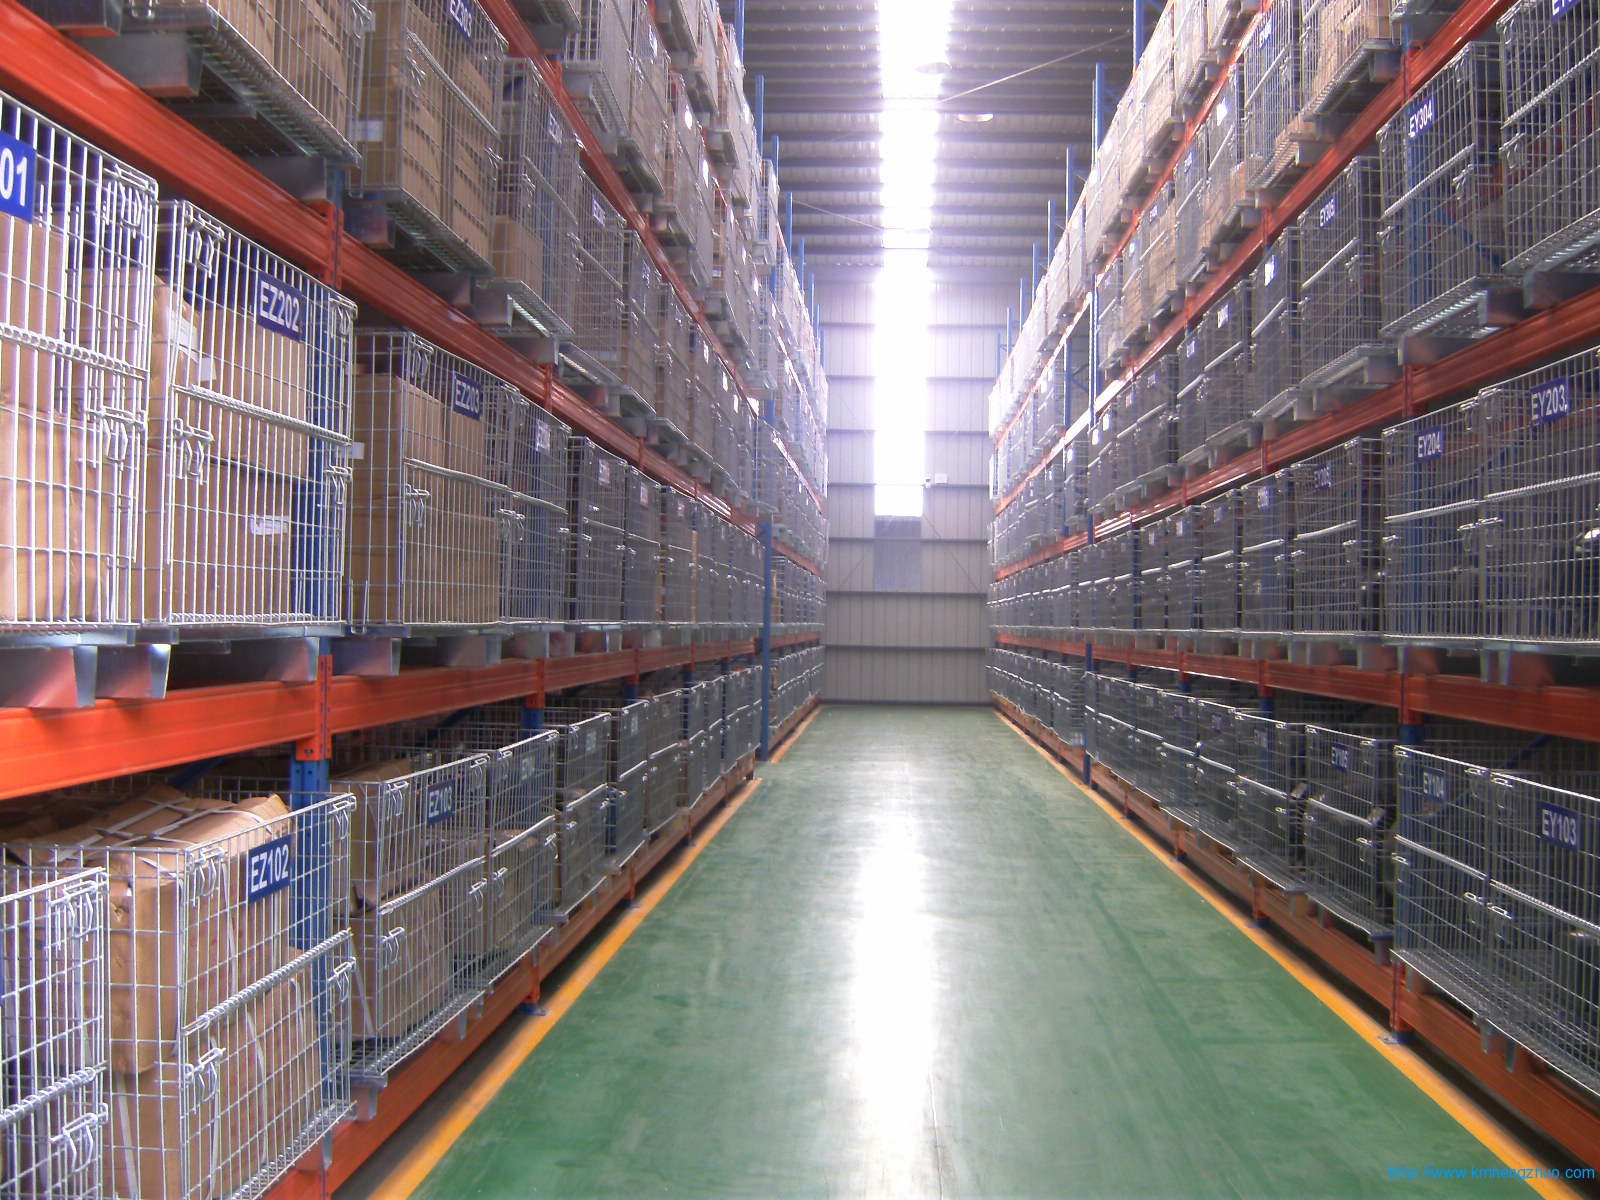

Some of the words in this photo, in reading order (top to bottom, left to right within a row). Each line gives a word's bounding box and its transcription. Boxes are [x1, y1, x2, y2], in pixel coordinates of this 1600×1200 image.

[1407, 99, 1432, 138] EY304
[260, 279, 300, 332] EZ202
[454, 379, 480, 414] EZ203
[1531, 384, 1566, 423] EY203
[1416, 431, 1441, 458] EY204
[1541, 809, 1576, 846] EY103
[249, 843, 288, 894] EZ102
